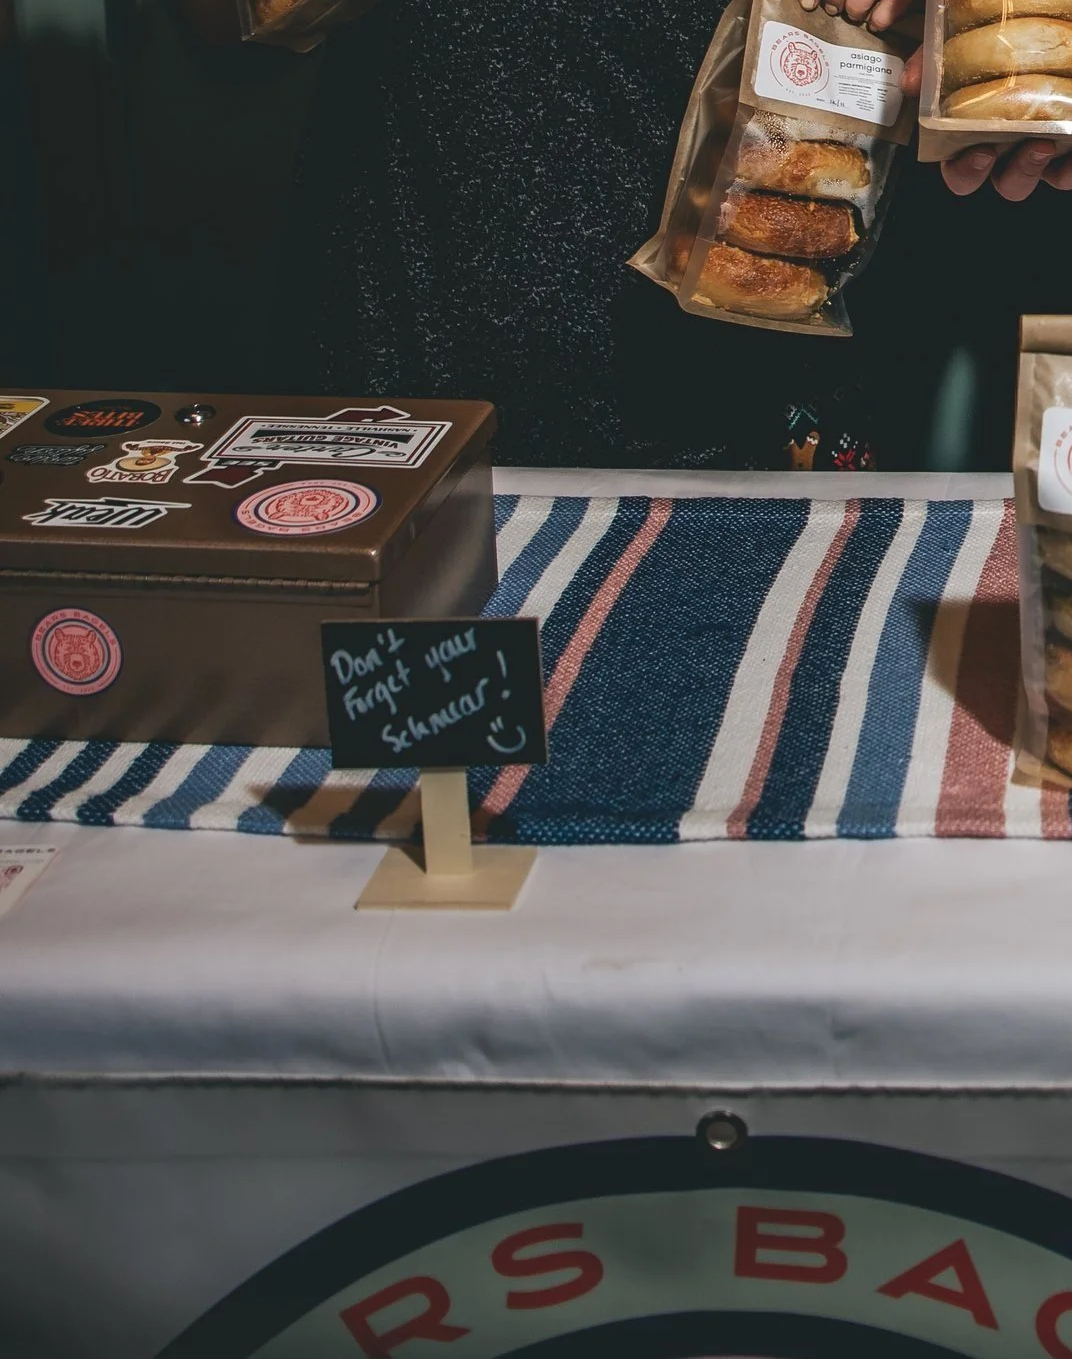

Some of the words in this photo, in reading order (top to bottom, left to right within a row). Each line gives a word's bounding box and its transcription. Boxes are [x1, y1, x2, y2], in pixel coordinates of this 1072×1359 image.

[771, 31, 800, 51] BEARS
[850, 52, 882, 64] asiago
[839, 61, 893, 75] parmigiana
[346, 425, 411, 433] NASHVILLE
[250, 435, 328, 444] GUITARS
[331, 436, 400, 450] VINTAGE
[267, 443, 377, 459] Carter
[240, 510, 292, 533] BAGELS
[300, 512, 363, 533] BEARS
[330, 627, 405, 685] Don't
[424, 627, 477, 683] your
